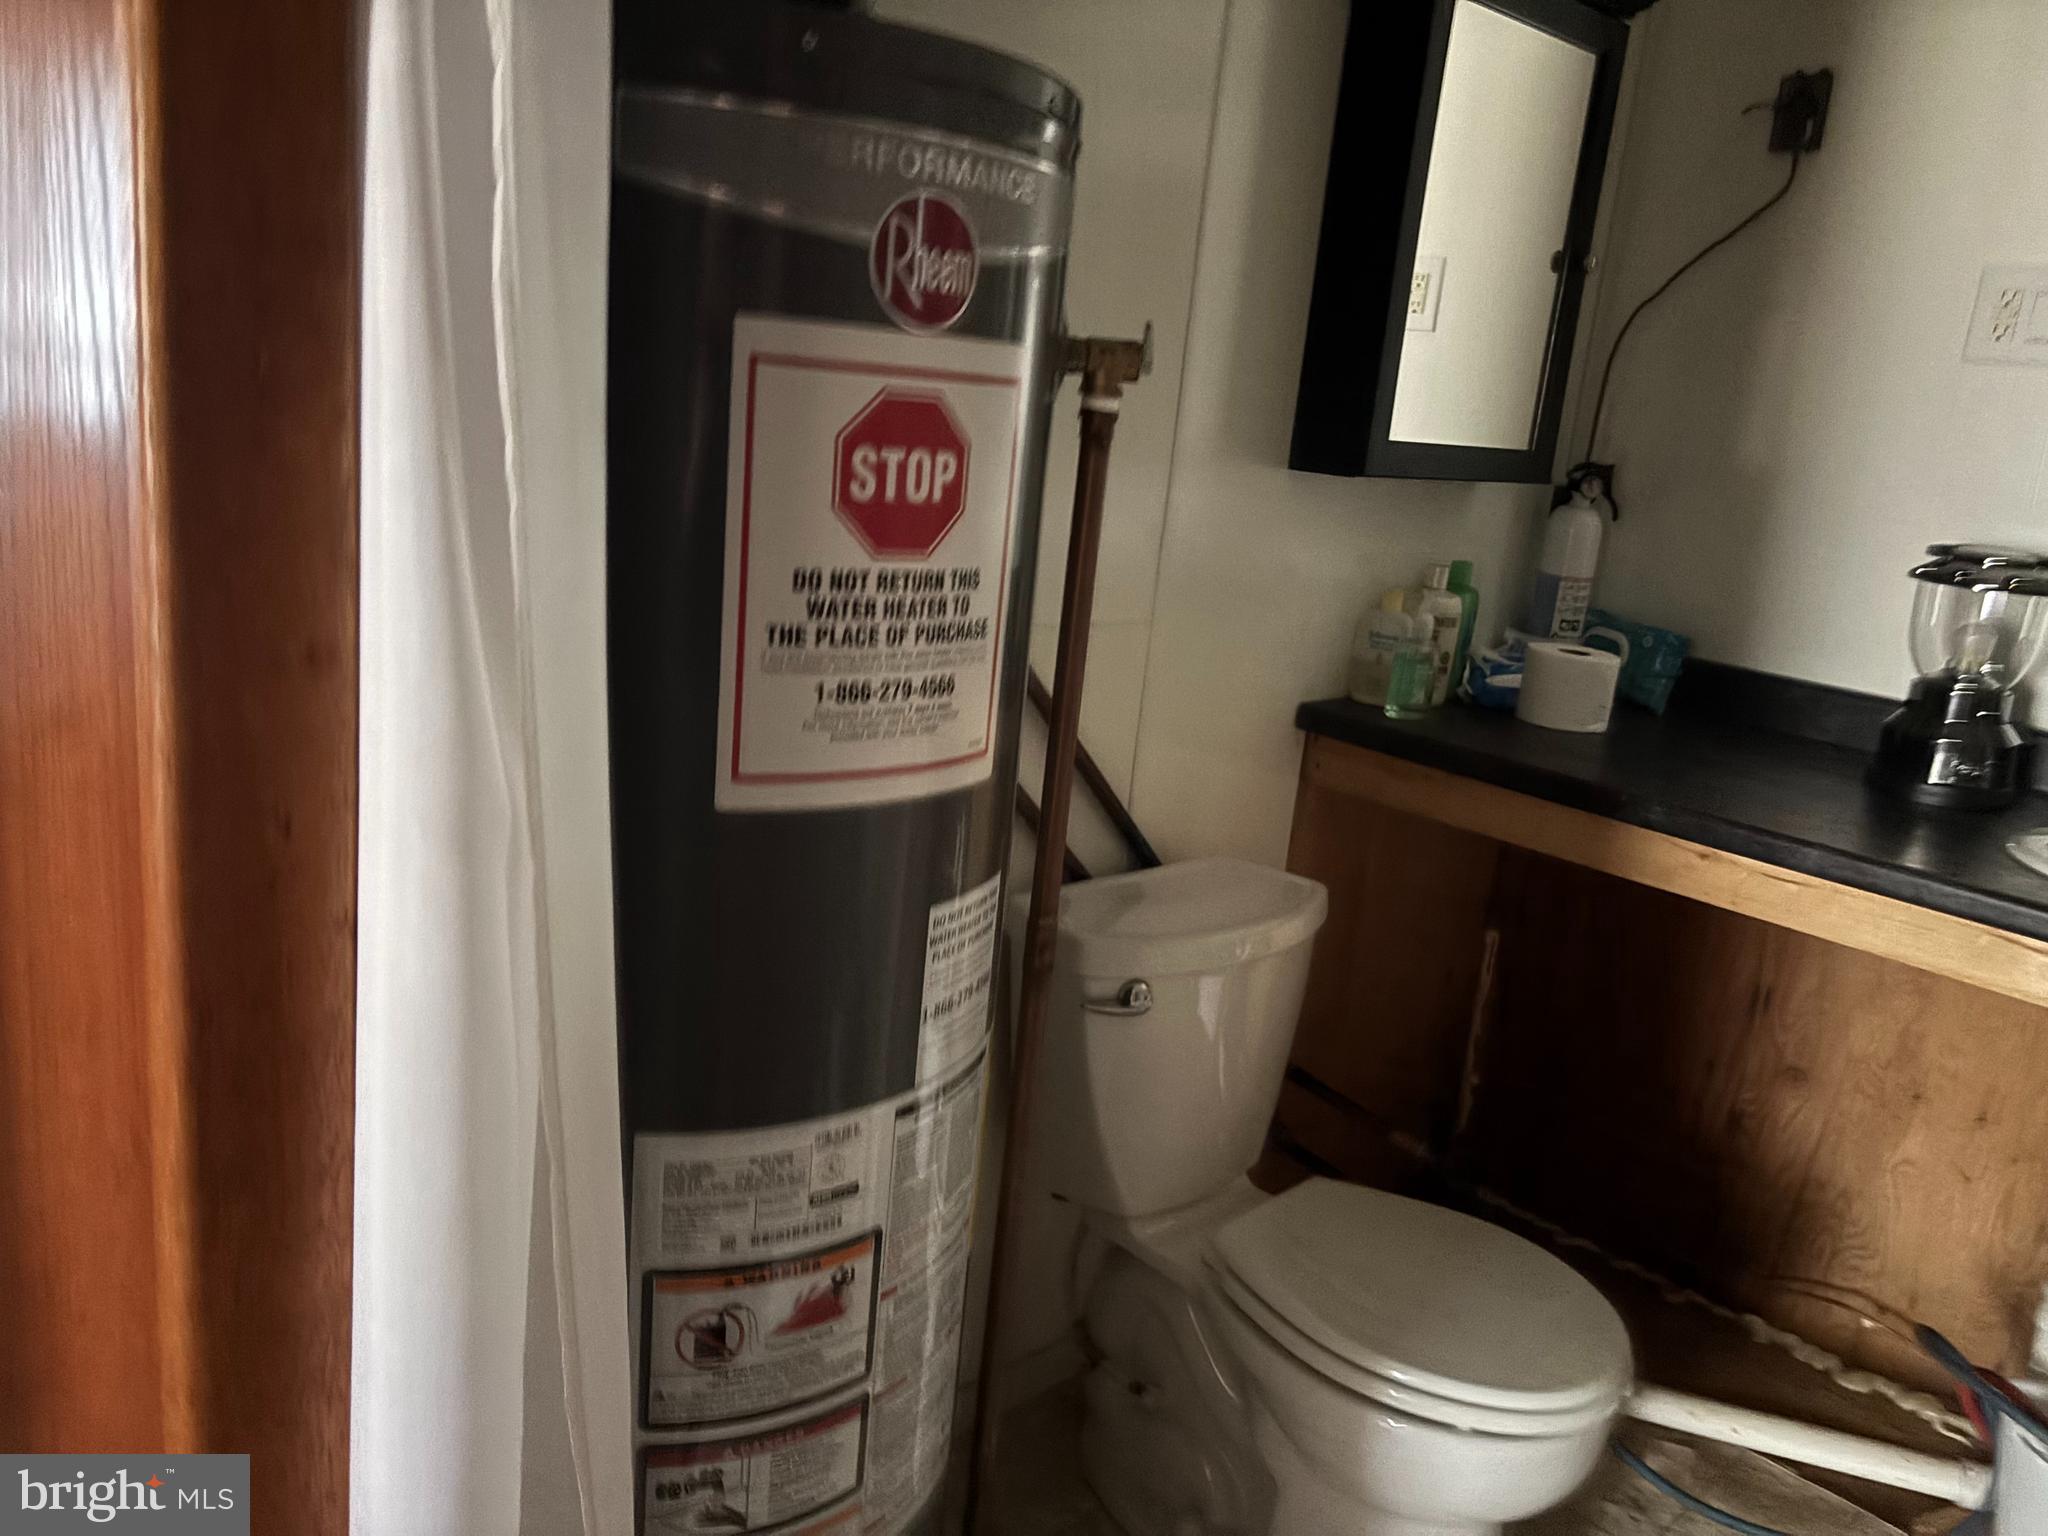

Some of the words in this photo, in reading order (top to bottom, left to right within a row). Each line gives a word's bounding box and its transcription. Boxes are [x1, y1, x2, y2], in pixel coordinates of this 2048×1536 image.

[850, 138, 1038, 205] RFORMANCE
[884, 193, 974, 311] Rheem
[850, 443, 957, 504] STOP
[791, 566, 822, 594] DO
[829, 566, 870, 594] NOT
[876, 566, 945, 594] RETURN
[950, 566, 981, 592] THIS
[806, 595, 876, 621] WATER
[882, 595, 948, 620] HEATER
[952, 594, 971, 618] TO
[767, 621, 806, 648] THE
[815, 621, 879, 648] PLACE
[886, 623, 909, 647] OF
[914, 617, 989, 646] PURCHASE
